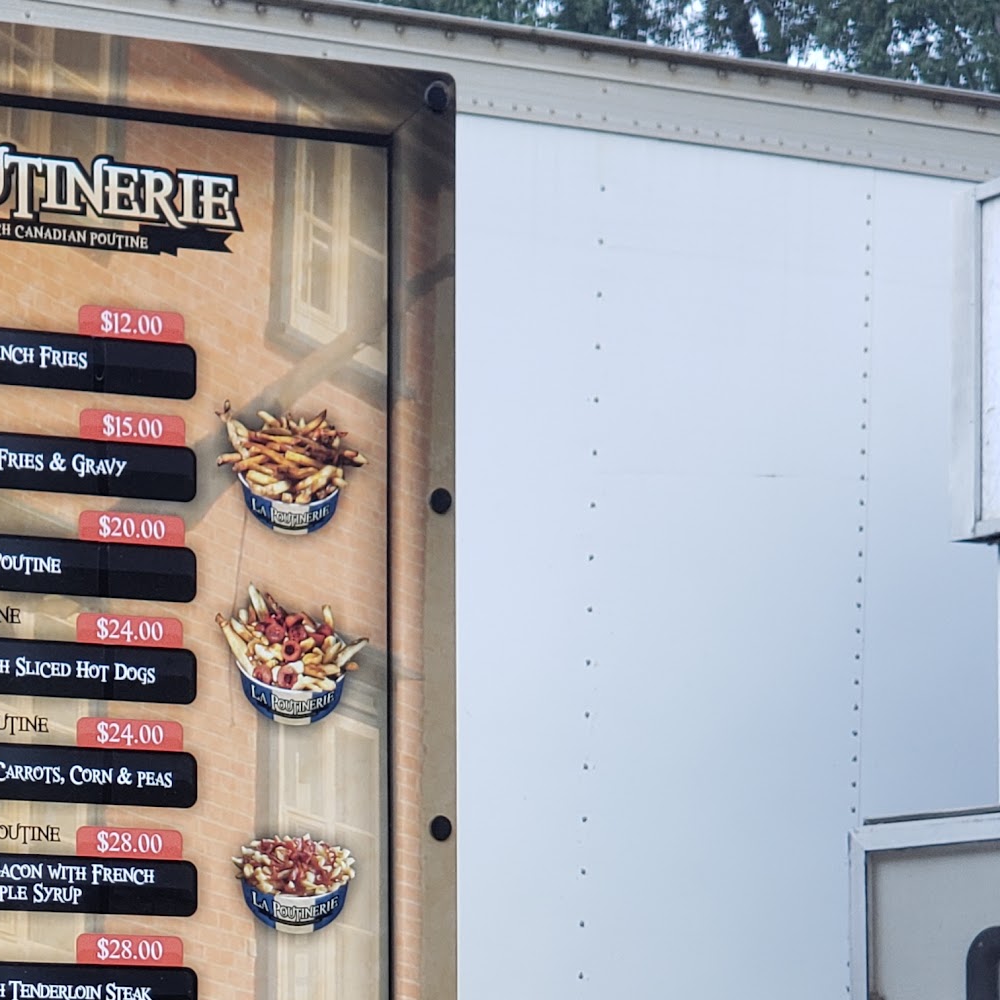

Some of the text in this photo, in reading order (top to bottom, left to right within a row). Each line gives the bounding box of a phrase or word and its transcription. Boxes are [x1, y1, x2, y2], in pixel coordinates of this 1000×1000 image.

[15, 223, 86, 243] CANADIAN
[89, 230, 149, 250] POUTINE
[100, 311, 163, 335] $12.00
[39, 345, 88, 370] FRIES
[103, 415, 163, 439] $15.00
[50, 453, 66, 472] &
[72, 454, 127, 477] GRAVY
[99, 515, 165, 540] $20.00
[96, 616, 163, 644] $24.00
[15, 657, 71, 678] SLICED
[76, 661, 109, 682] HOT
[114, 662, 156, 685] DOGS
[96, 721, 163, 746] $24.00
[70, 765, 113, 784] CORN
[117, 767, 132, 784] &
[137, 771, 173, 788] PEAS
[97, 831, 162, 854] $28.00
[47, 863, 87, 883] WITH
[91, 863, 155, 884] FRENCH
[33, 883, 82, 906] SYRUP
[97, 938, 163, 961] $28.00
